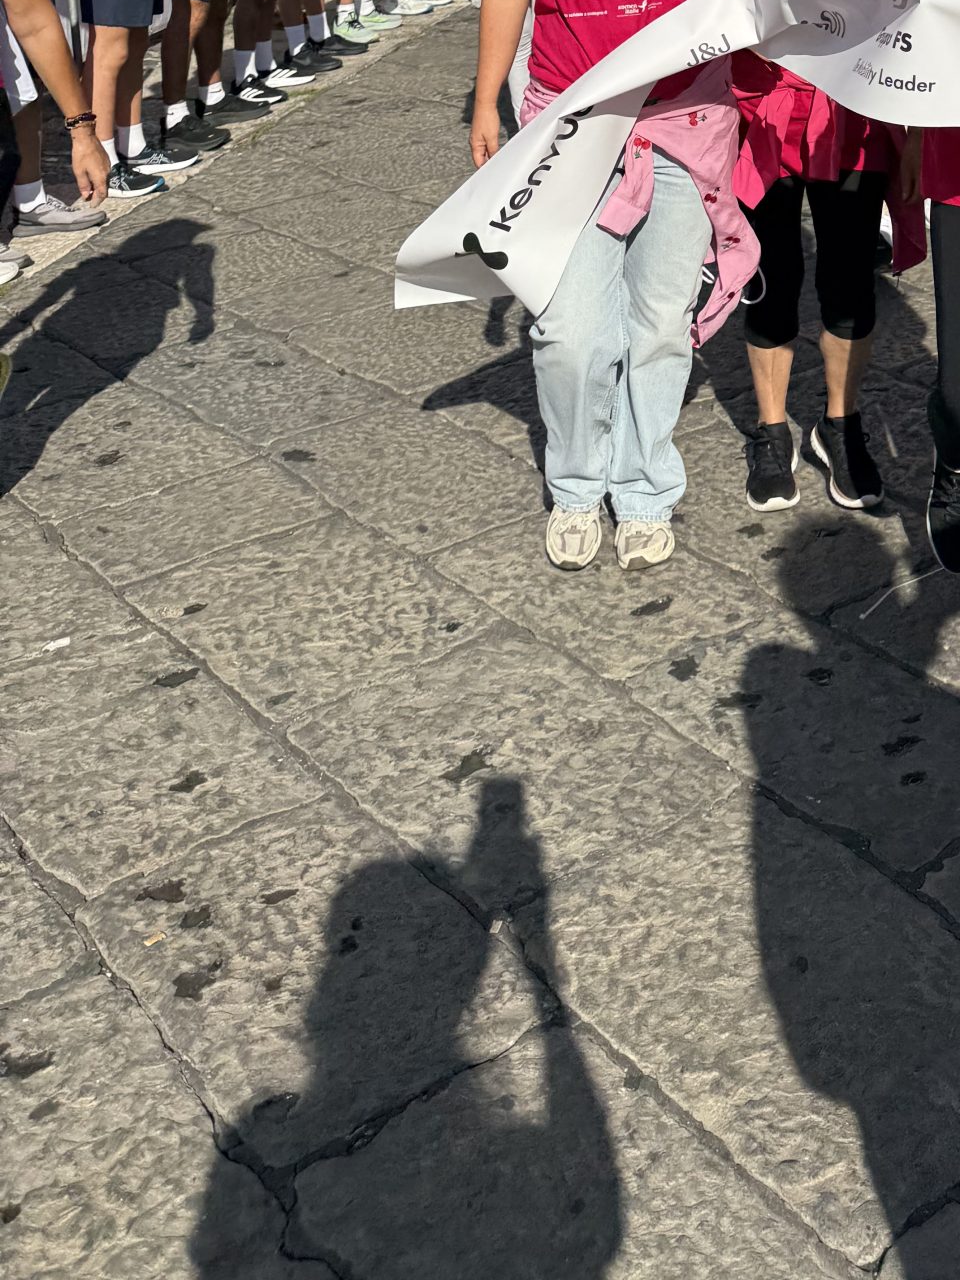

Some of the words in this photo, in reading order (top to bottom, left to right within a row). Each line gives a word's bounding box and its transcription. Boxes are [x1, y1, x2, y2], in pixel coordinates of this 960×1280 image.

[686, 33, 731, 68] J&J
[892, 30, 912, 52] FS
[878, 68, 936, 92] Leader
